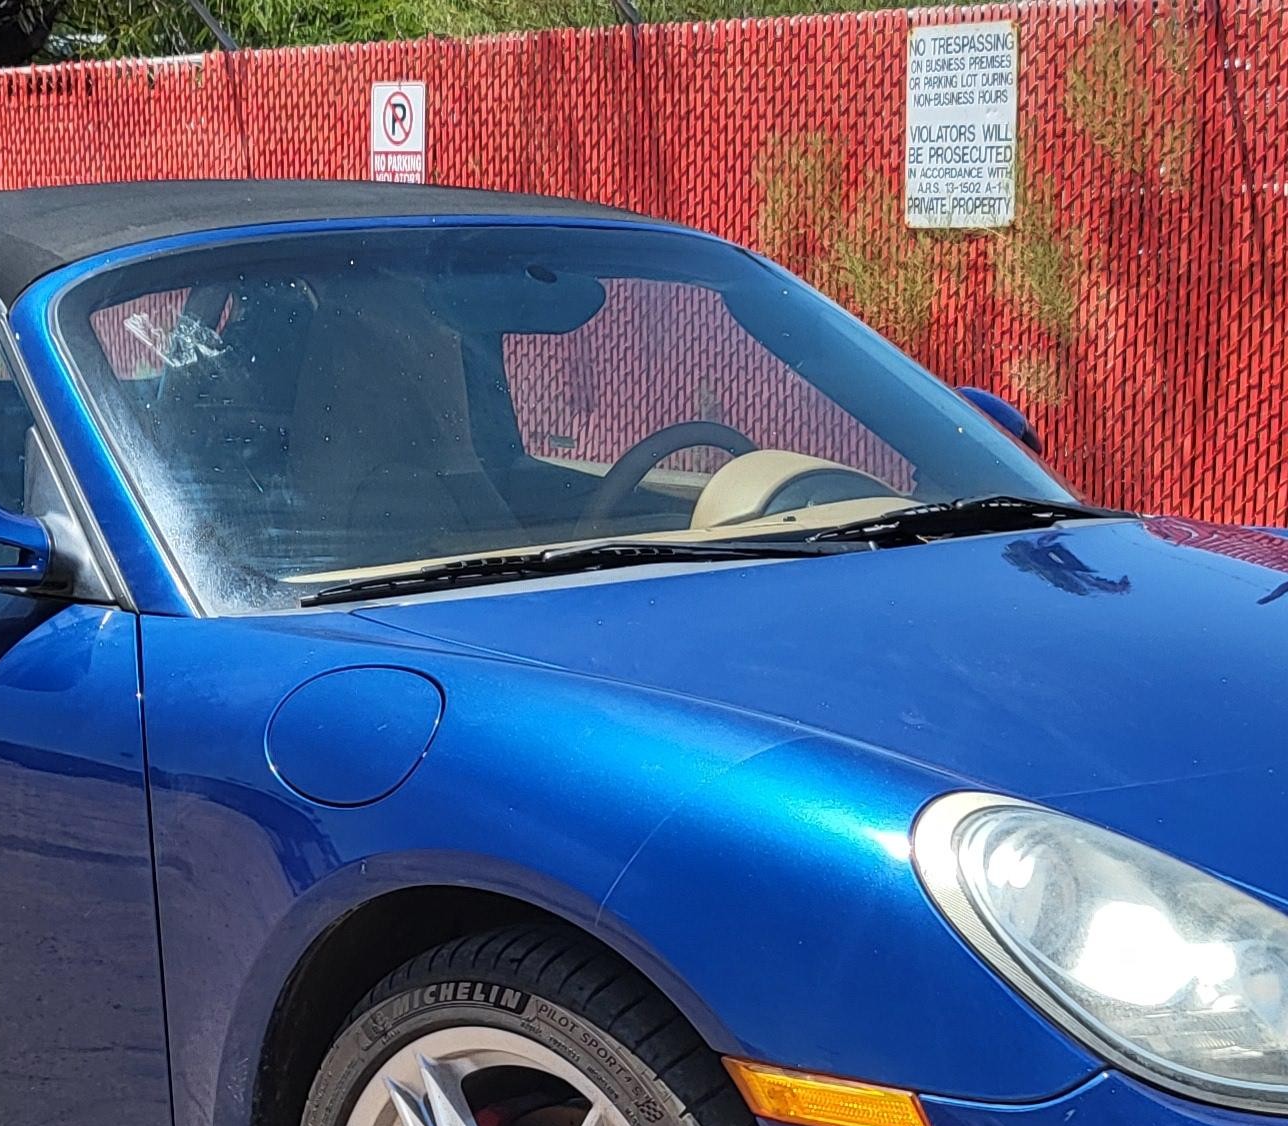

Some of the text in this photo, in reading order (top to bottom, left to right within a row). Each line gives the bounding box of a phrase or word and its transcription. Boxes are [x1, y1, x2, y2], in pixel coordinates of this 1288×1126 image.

[909, 32, 1015, 56] NO TRESPASSING
[911, 54, 1012, 74] ON BUSINESS PREMISES
[909, 71, 1014, 90] OR PARKING LOT DURING
[913, 89, 1008, 107] NON-BUSINESS HOURS
[910, 123, 1012, 143] VIOLATORS WILL
[375, 154, 422, 172] NO PARKING
[908, 145, 1013, 164] BE PROSECUTED
[908, 166, 1013, 179] IN ACCORDANCE WITH
[944, 181, 981, 194] 13-1502
[907, 196, 1012, 215] PRIVATE PROPERTY
[392, 981, 523, 1017] MICHELIN
[537, 1003, 580, 1034] PILOT
[579, 1032, 626, 1075] SPORT
